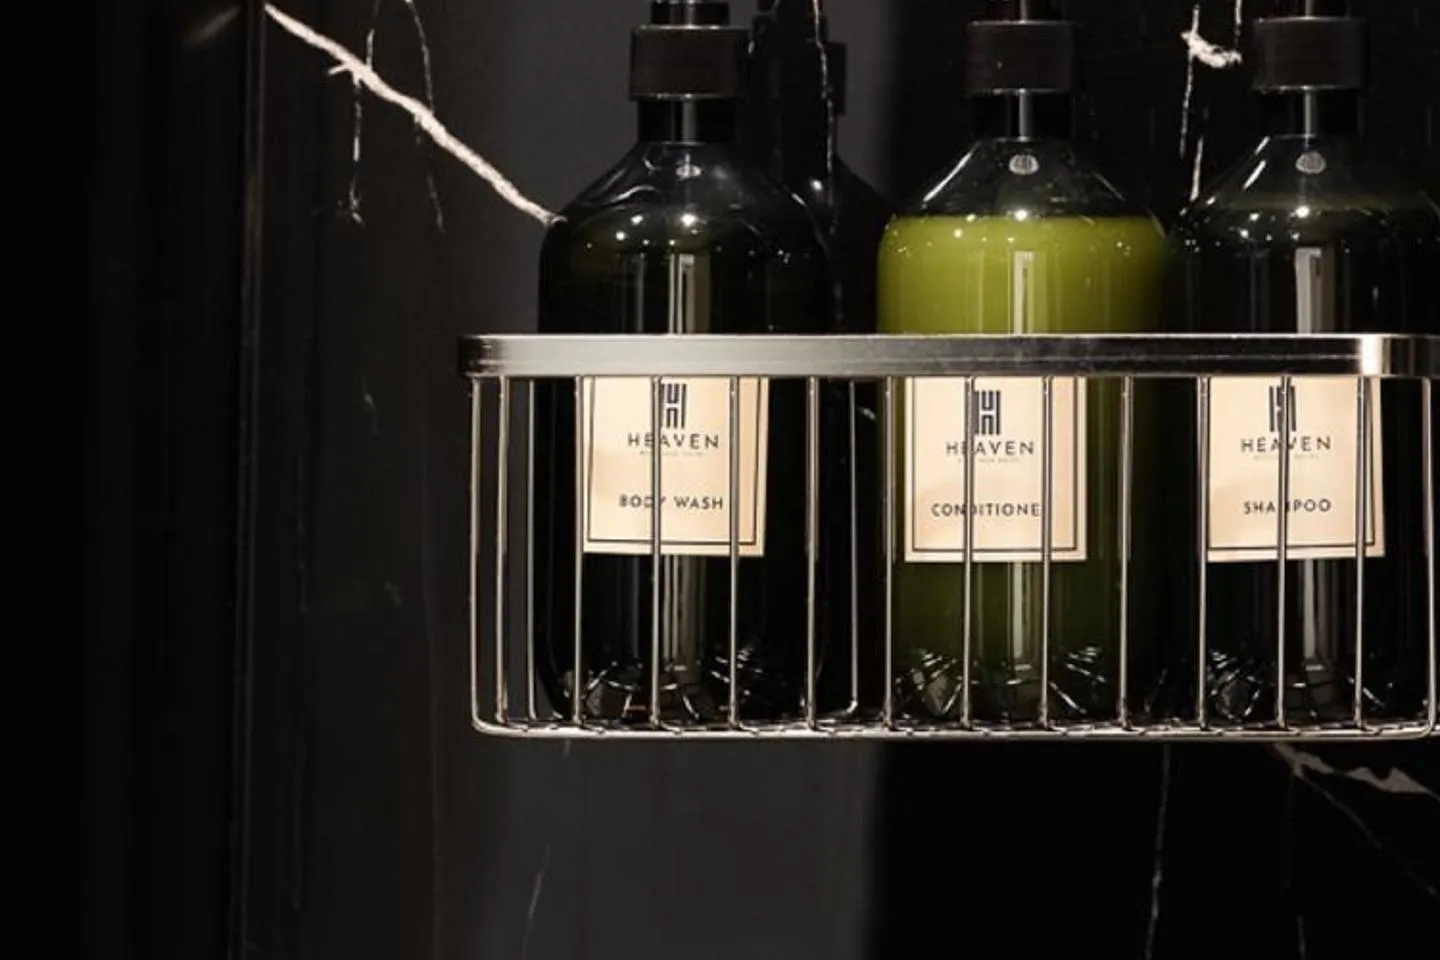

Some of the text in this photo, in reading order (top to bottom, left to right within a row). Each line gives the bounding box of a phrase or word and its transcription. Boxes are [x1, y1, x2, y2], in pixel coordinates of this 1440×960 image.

[627, 432, 719, 449] HEAVEN
[1240, 436, 1332, 453] HEAVEN
[673, 496, 723, 510] WASH
[930, 502, 1050, 518] CONITIONE
[1243, 498, 1332, 515] SHAPOO
